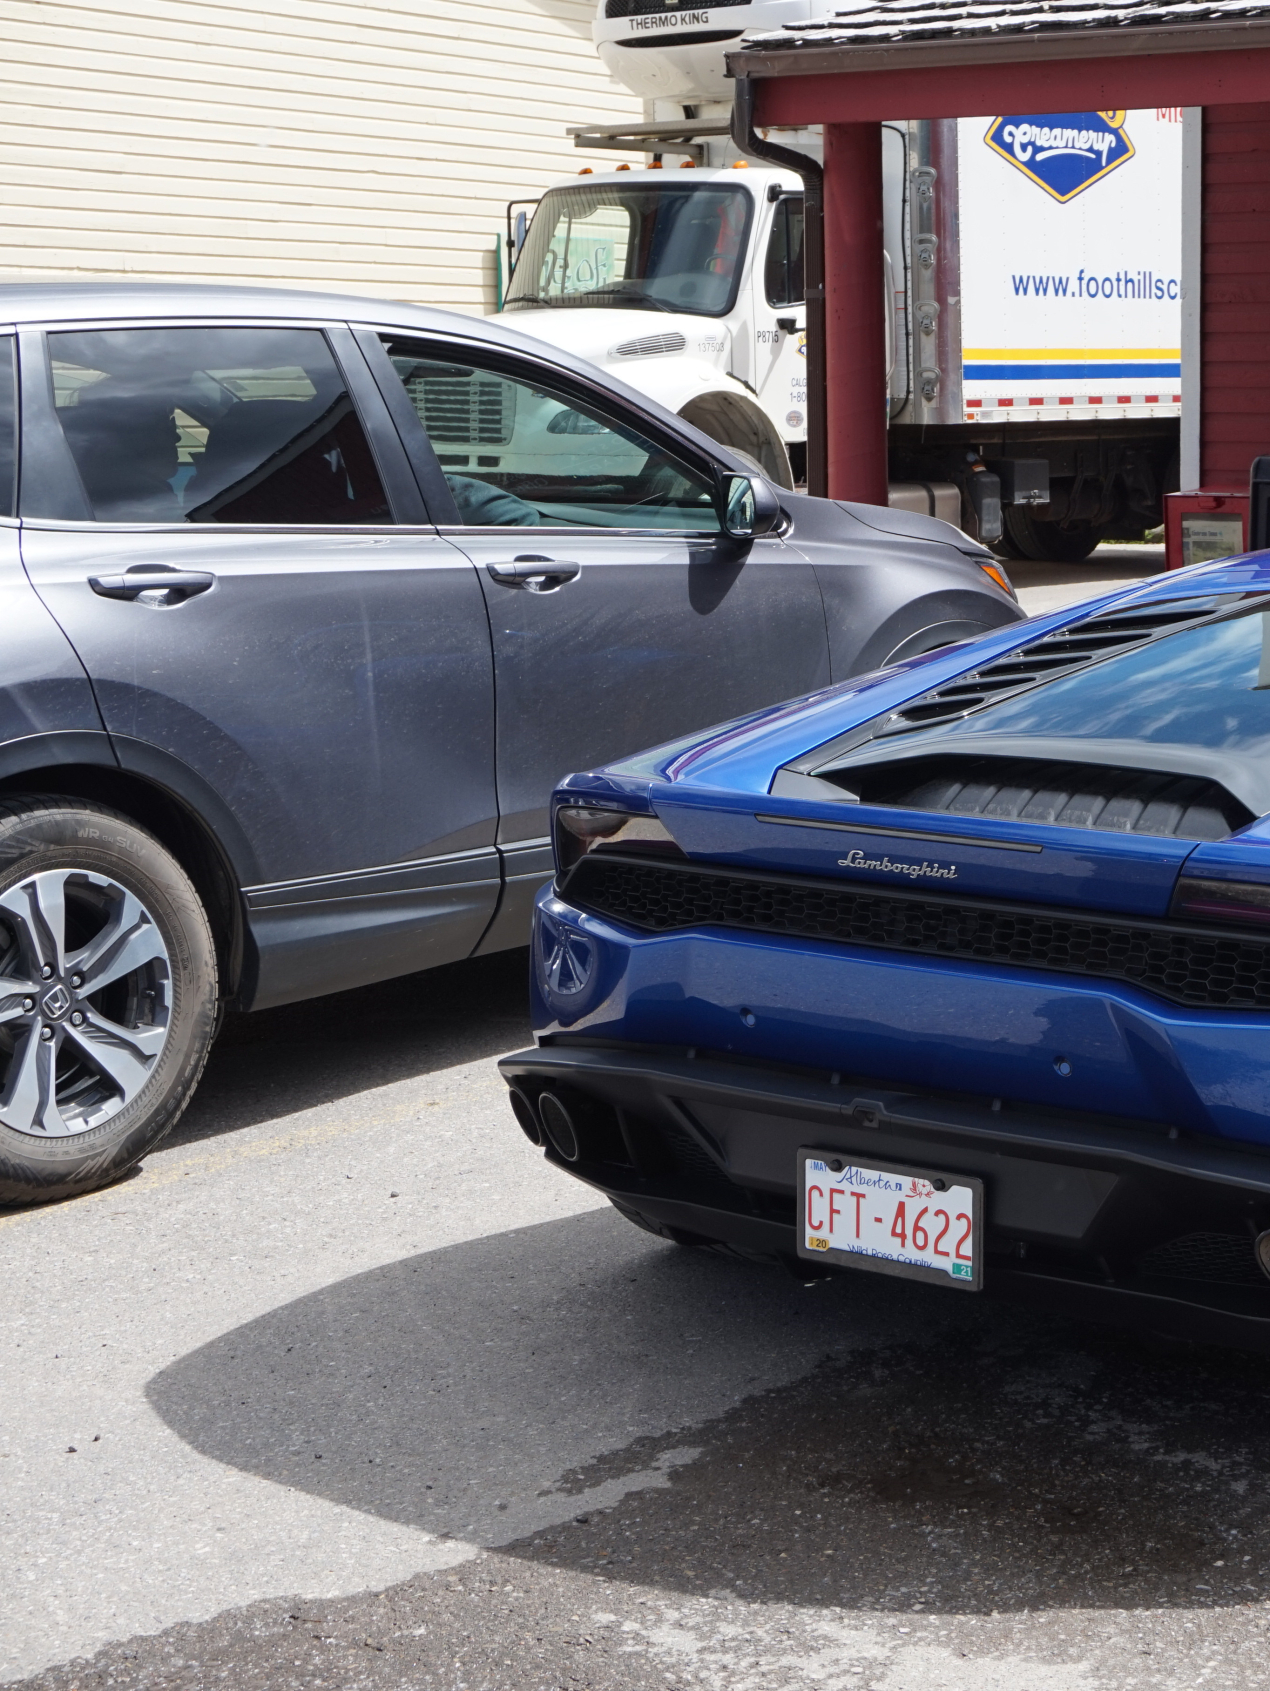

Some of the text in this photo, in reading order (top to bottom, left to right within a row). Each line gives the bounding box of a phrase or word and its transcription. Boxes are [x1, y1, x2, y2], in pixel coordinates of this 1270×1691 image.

[628, 11, 709, 31] THERMO KING
[1003, 123, 1116, 167] Creamery
[1011, 269, 1182, 300] www.foothillsc
[698, 342, 725, 353] 137503
[837, 850, 958, 879] Lamborghini
[813, 1161, 828, 1172] MAY
[835, 1165, 893, 1191] Alberta
[807, 1184, 972, 1262] CFT-4622
[816, 1238, 827, 1249] 20
[871, 1248, 894, 1261] Rose
[960, 1266, 971, 1276] 21
